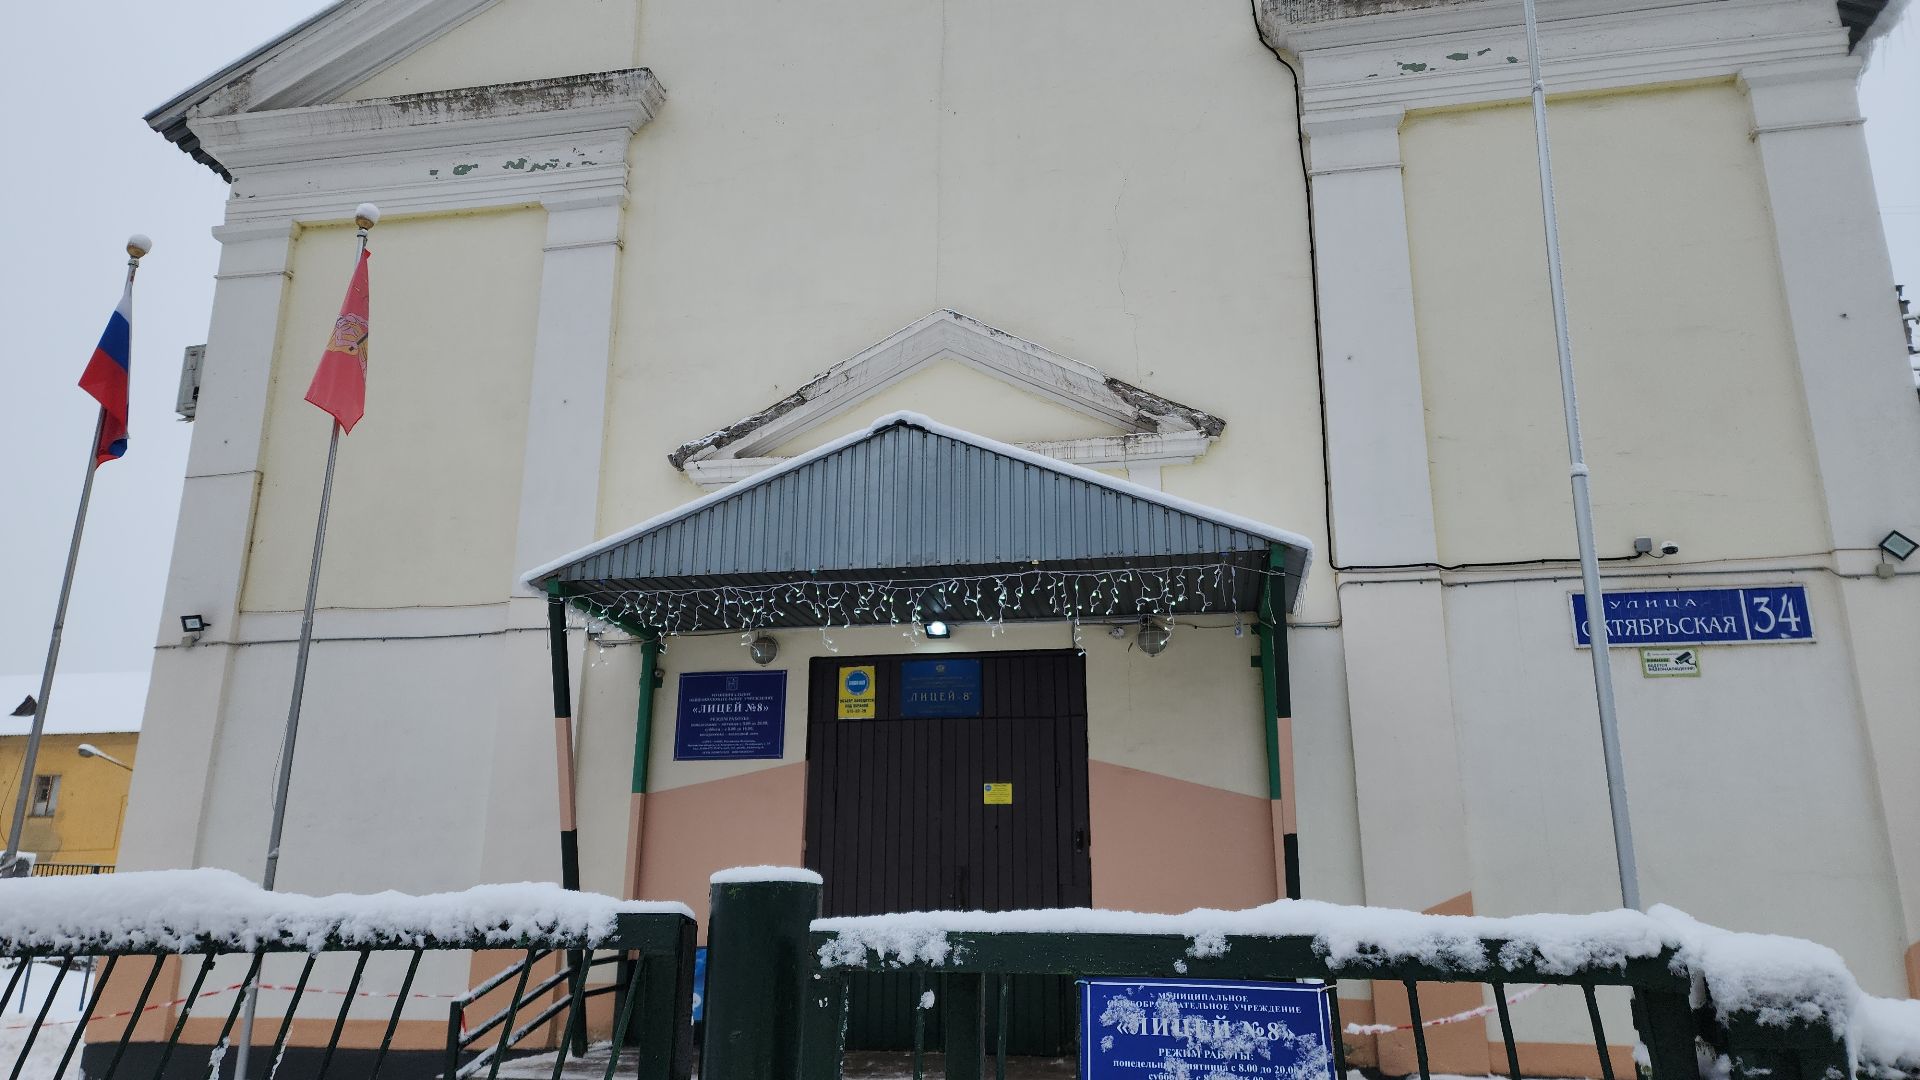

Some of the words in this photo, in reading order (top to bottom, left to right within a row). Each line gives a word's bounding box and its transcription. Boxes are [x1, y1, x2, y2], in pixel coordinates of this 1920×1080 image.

[1609, 599, 1697, 609] УЛИЦА
[1753, 594, 1801, 634] 34
[692, 701, 742, 713] «ЛИЦЕЙ
[745, 703, 769, 712] №8»
[1158, 992, 1249, 1003] МУНИЦИПАЛЬНОЕ
[1107, 1000, 1229, 1011] ЕОБРААТЕЛЬНОЕ
[1234, 1003, 1302, 1014] УЧРЕЖДЕНИЕ
[1158, 1048, 1201, 1059] РЕЖИМ
[1113, 1060, 1168, 1069] понедельни
[1238, 1064, 1258, 1073] 8.00
[1260, 1066, 1272, 1074] до
[1274, 1065, 1296, 1075] 20.0
